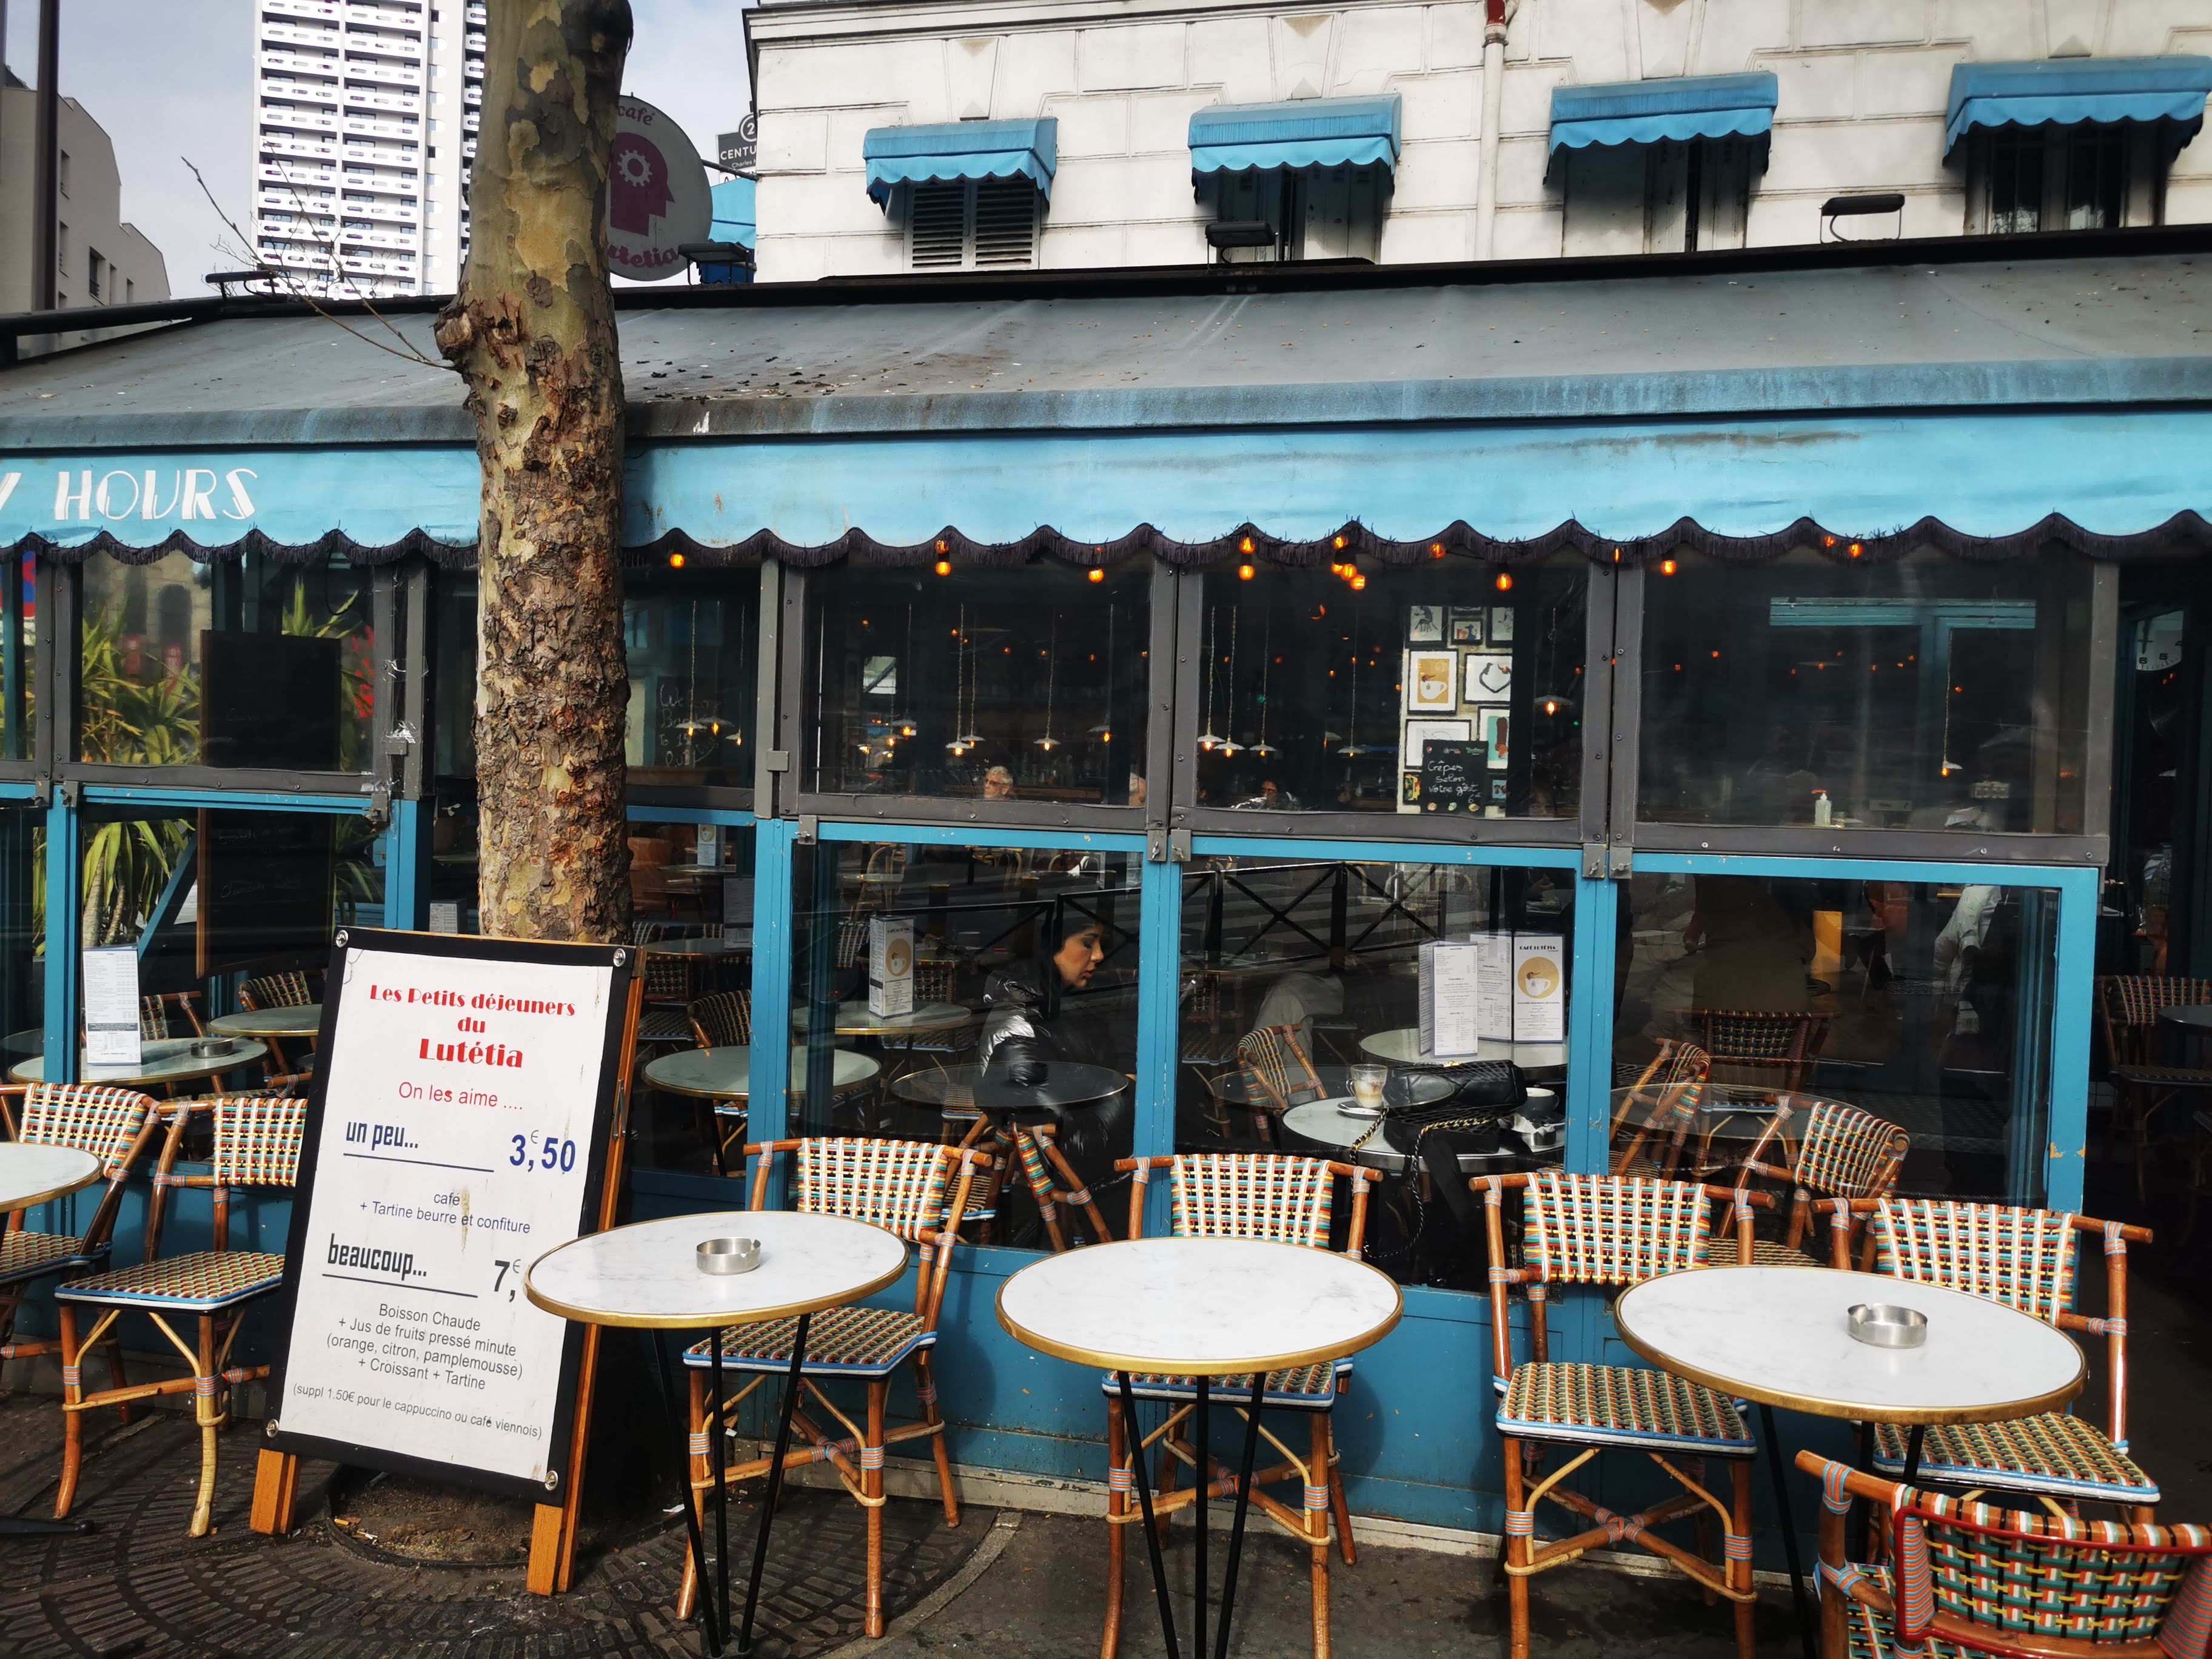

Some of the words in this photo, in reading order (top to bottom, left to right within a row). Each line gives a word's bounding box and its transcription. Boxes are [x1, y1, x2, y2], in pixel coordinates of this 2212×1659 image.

[617, 106, 655, 126] café
[747, 122, 756, 135] 2
[720, 146, 757, 160] CENTU
[55, 468, 258, 520] HOURS
[1428, 760, 1463, 776] Crêpes
[370, 984, 402, 1002] Les
[407, 988, 466, 1008] Petits
[471, 993, 575, 1016] déjeuners
[457, 1016, 486, 1033] du
[419, 1038, 523, 1068] Lutétia
[398, 1081, 423, 1100] On
[429, 1084, 453, 1103] les
[458, 1089, 498, 1107] aime
[346, 1121, 368, 1144] un
[433, 1190, 461, 1207] café
[372, 1201, 413, 1218] Tartine
[417, 1207, 457, 1224] beurre
[460, 1213, 474, 1227] et
[477, 1217, 531, 1234] confiture
[379, 1303, 428, 1323] Boisson
[432, 1311, 481, 1331] Chaude
[350, 1318, 372, 1333] Jus
[375, 1322, 391, 1336] de
[395, 1324, 426, 1341] fruits
[428, 1333, 471, 1349] pressé
[475, 1338, 516, 1356] minute
[327, 1333, 377, 1354] (orange,
[382, 1343, 419, 1361] citron,
[423, 1351, 523, 1381] pamplemousse)
[370, 1358, 429, 1380] Croissant
[445, 1370, 486, 1390] Tartine
[328, 1388, 355, 1403] 1.50€
[357, 1395, 381, 1406] pour
[383, 1397, 392, 1409] le
[394, 1402, 452, 1420] cappuccino
[455, 1413, 468, 1423] ou
[470, 1415, 492, 1428] café
[495, 1421, 542, 1441] viennois)
